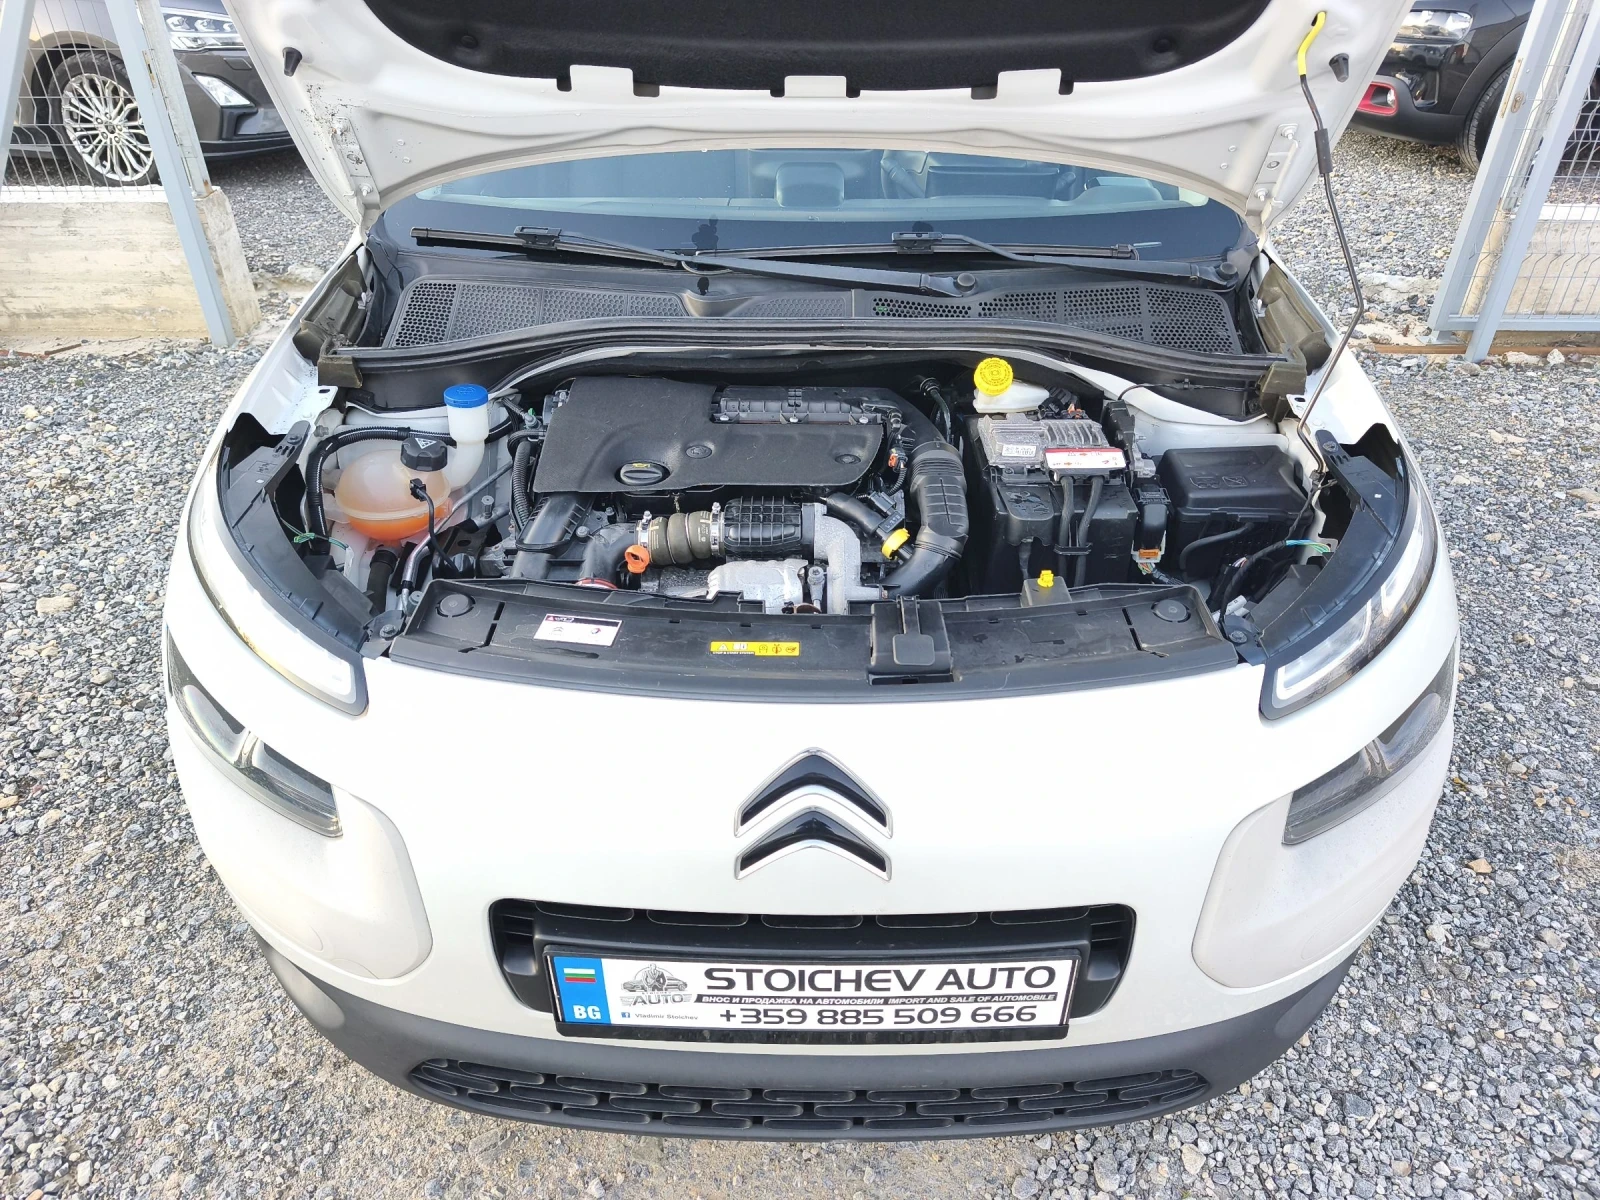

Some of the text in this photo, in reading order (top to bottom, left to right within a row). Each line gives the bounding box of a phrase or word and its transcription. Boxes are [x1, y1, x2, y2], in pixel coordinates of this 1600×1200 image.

[704, 965, 1057, 993] STOICHEV AUTO
[632, 994, 684, 1006] AUTO
[741, 997, 798, 1005] ПРОДАЖБА
[992, 994, 1055, 1002] AUTOMOBILE
[573, 1005, 602, 1020] BG
[720, 1005, 1037, 1025] +359 885 509 666
